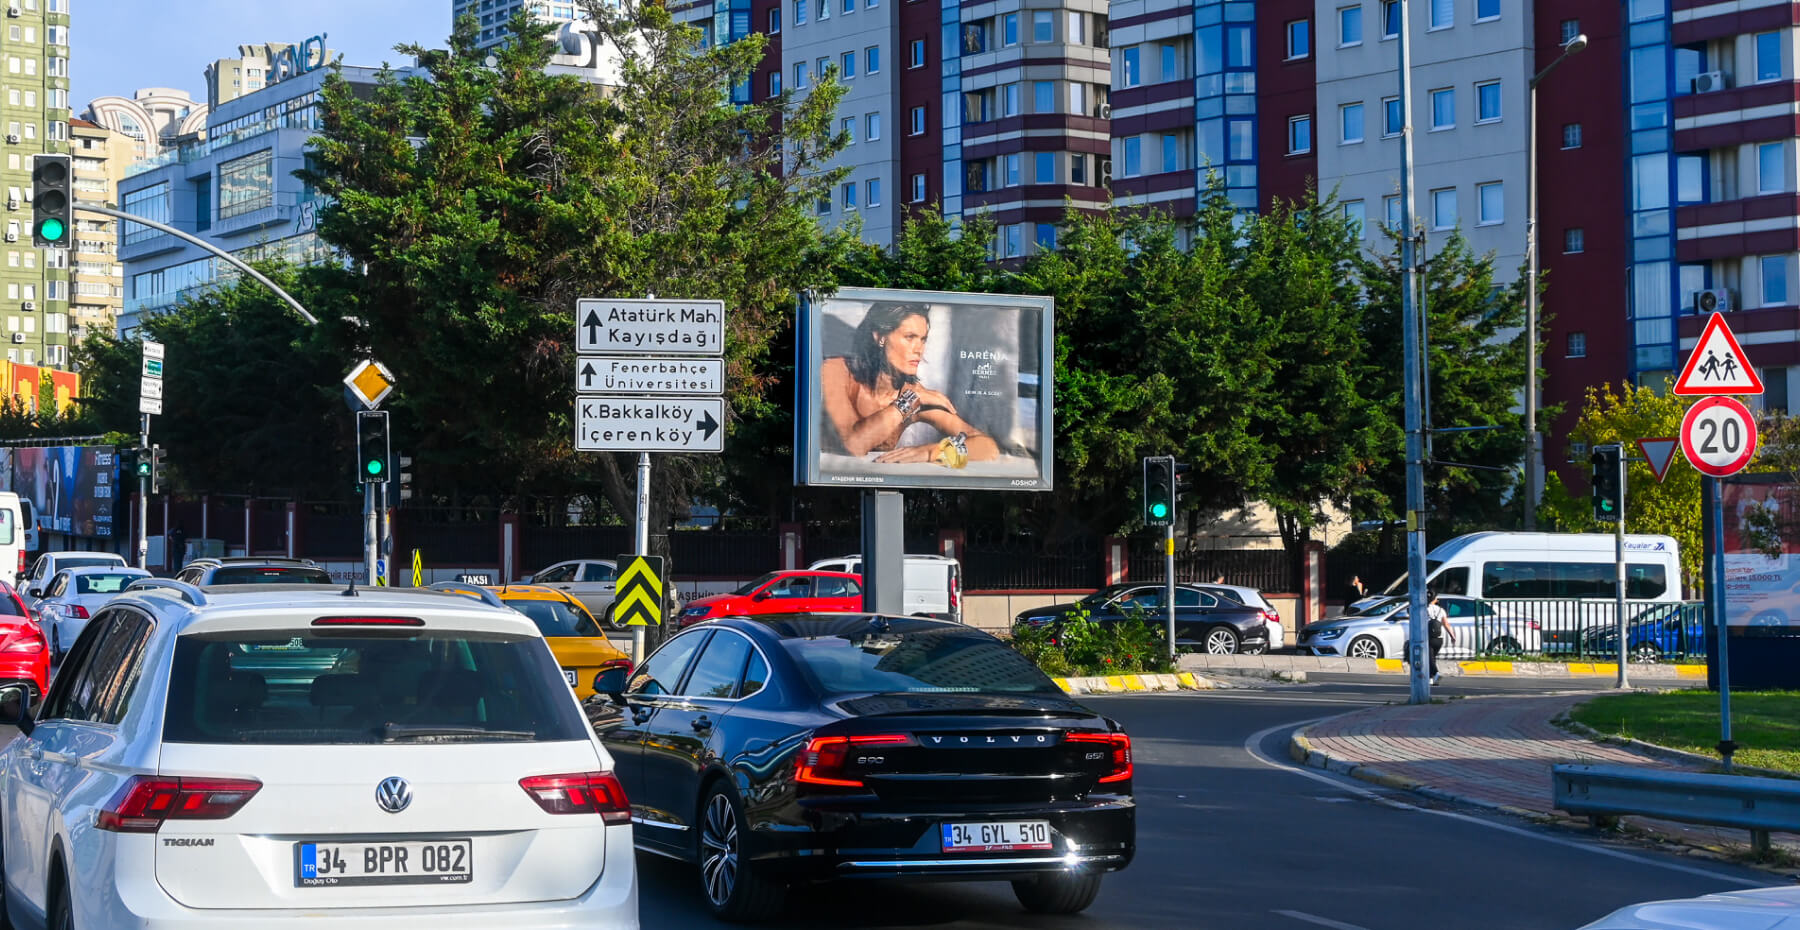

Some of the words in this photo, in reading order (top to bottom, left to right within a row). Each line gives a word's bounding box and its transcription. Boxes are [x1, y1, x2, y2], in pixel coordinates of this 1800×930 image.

[608, 308, 675, 322] Atatürk
[680, 308, 720, 323] Mah.
[608, 328, 716, 347] Kayışdağı
[611, 362, 707, 375] Fenerbahçe
[605, 375, 713, 389] Üniversitesi
[582, 404, 693, 423] K.Bakkalköy
[582, 422, 693, 446] İçerenköy
[1699, 418, 1740, 453] 20
[931, 735, 1045, 744] VOLVO
[857, 756, 885, 764] S90
[952, 826, 972, 845] 34
[981, 825, 1010, 843] GYL
[1020, 824, 1045, 842] 510
[163, 838, 215, 847] TIGUAN
[317, 847, 346, 874] 34
[364, 846, 408, 873] BPR
[422, 845, 466, 872] 082
[304, 864, 316, 873] TR
